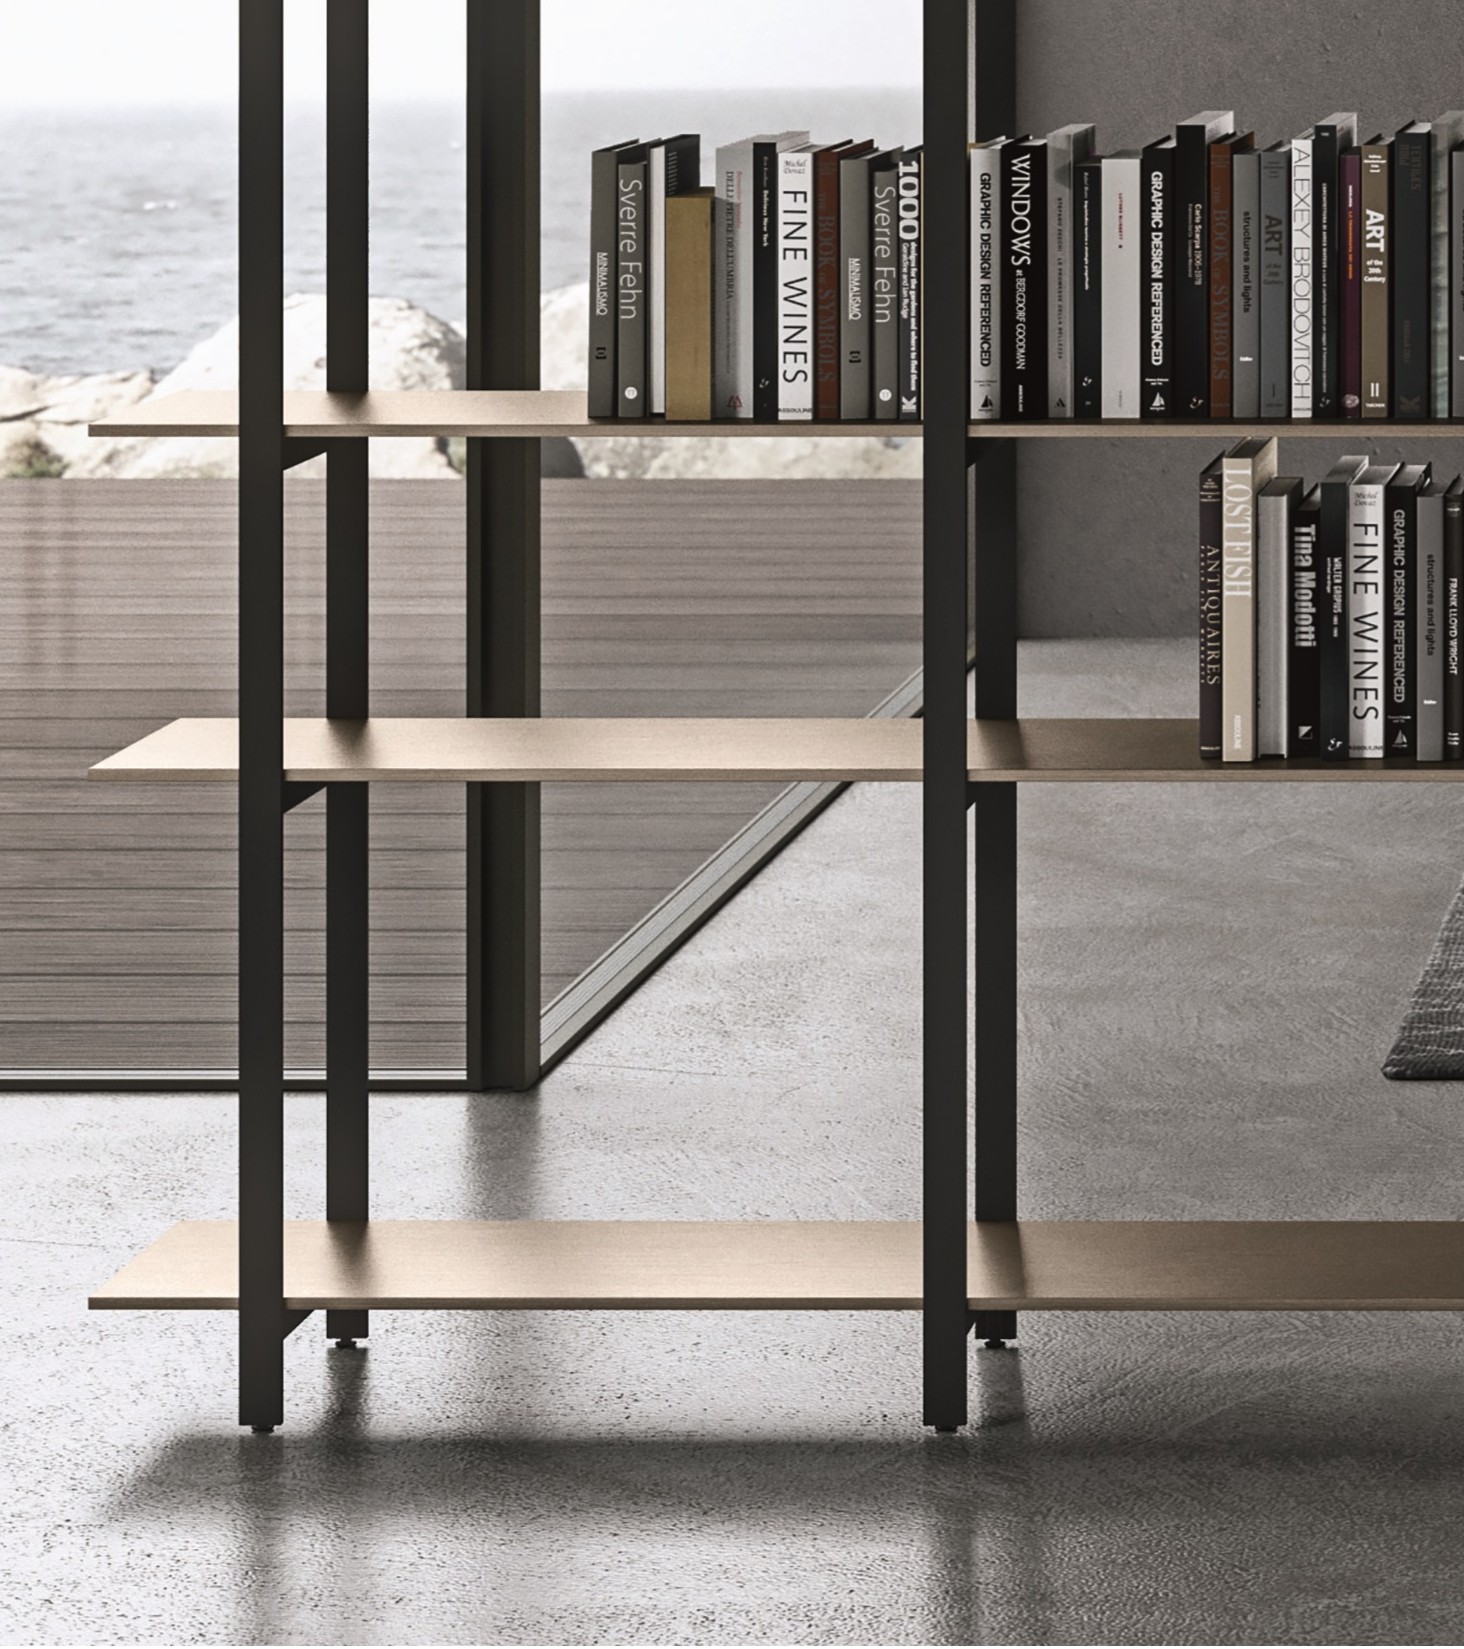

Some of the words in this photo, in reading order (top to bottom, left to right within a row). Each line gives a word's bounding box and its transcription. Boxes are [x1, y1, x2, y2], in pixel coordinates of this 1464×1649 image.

[620, 179, 642, 253] Sverre
[1151, 172, 1163, 229] GRAPHIC
[620, 261, 642, 319] Fehn
[1151, 232, 1163, 279] DESIGN
[1151, 282, 1163, 366] REFERENCED
[1293, 524, 1317, 567] Tina
[1353, 523, 1378, 595] FINE
[1293, 571, 1317, 647] Modotti
[1353, 612, 1378, 720] WINES
